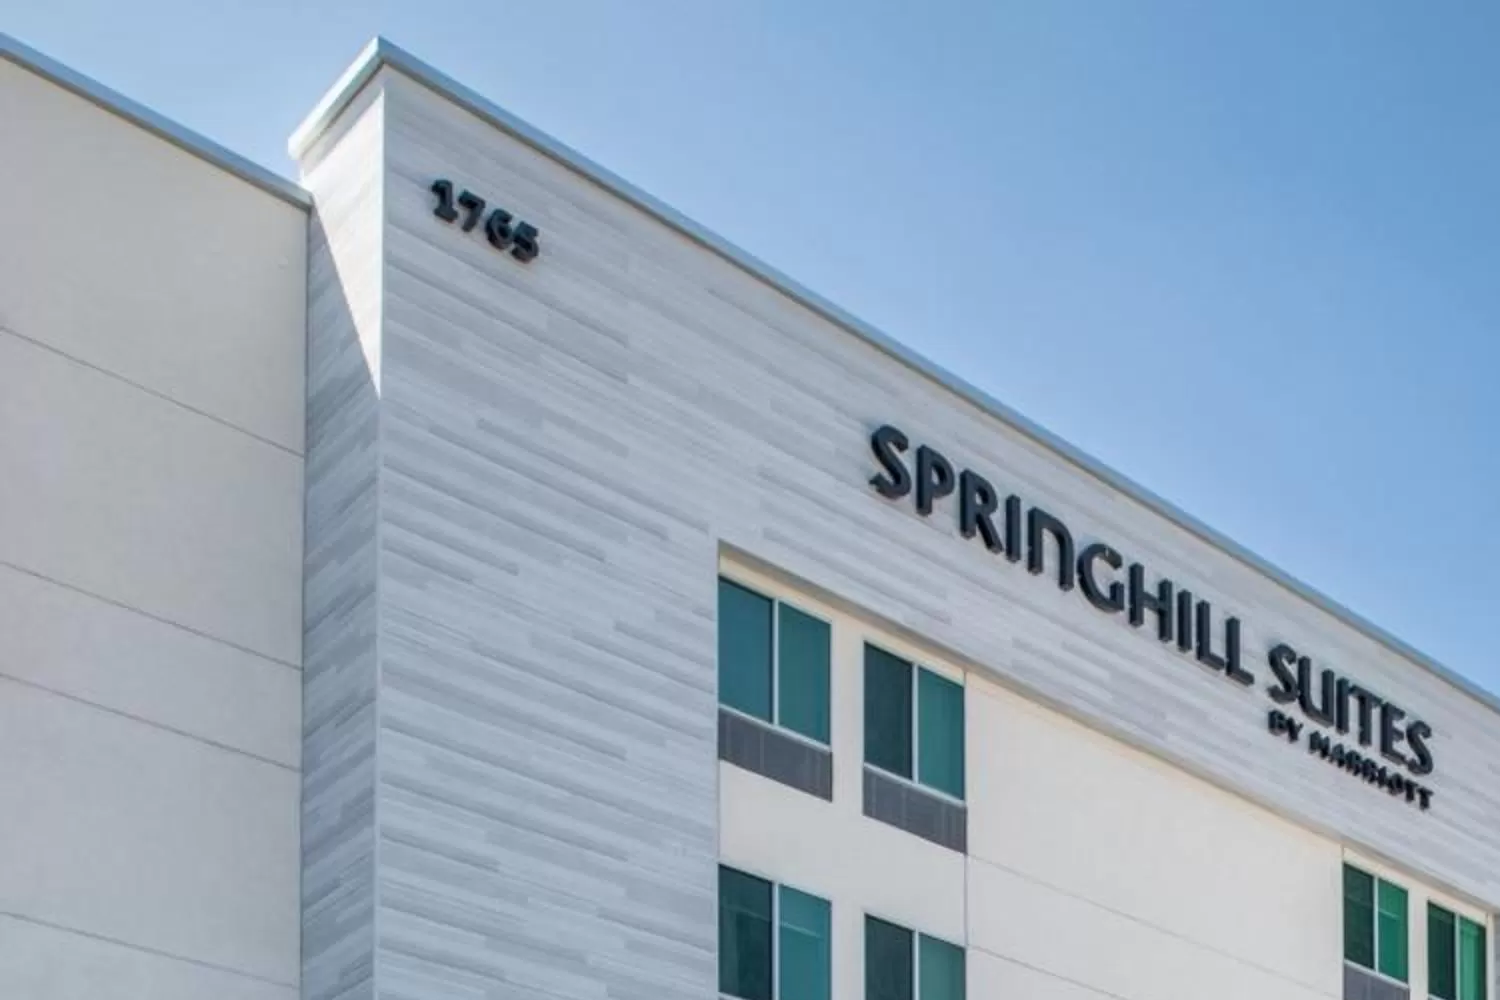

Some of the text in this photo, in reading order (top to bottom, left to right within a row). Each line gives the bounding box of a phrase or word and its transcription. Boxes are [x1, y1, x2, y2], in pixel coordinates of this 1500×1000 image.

[431, 179, 539, 264] 1765
[869, 424, 1434, 776] SPRINGHILL SUITES
[1268, 709, 1434, 811] BY MARRIOTT
